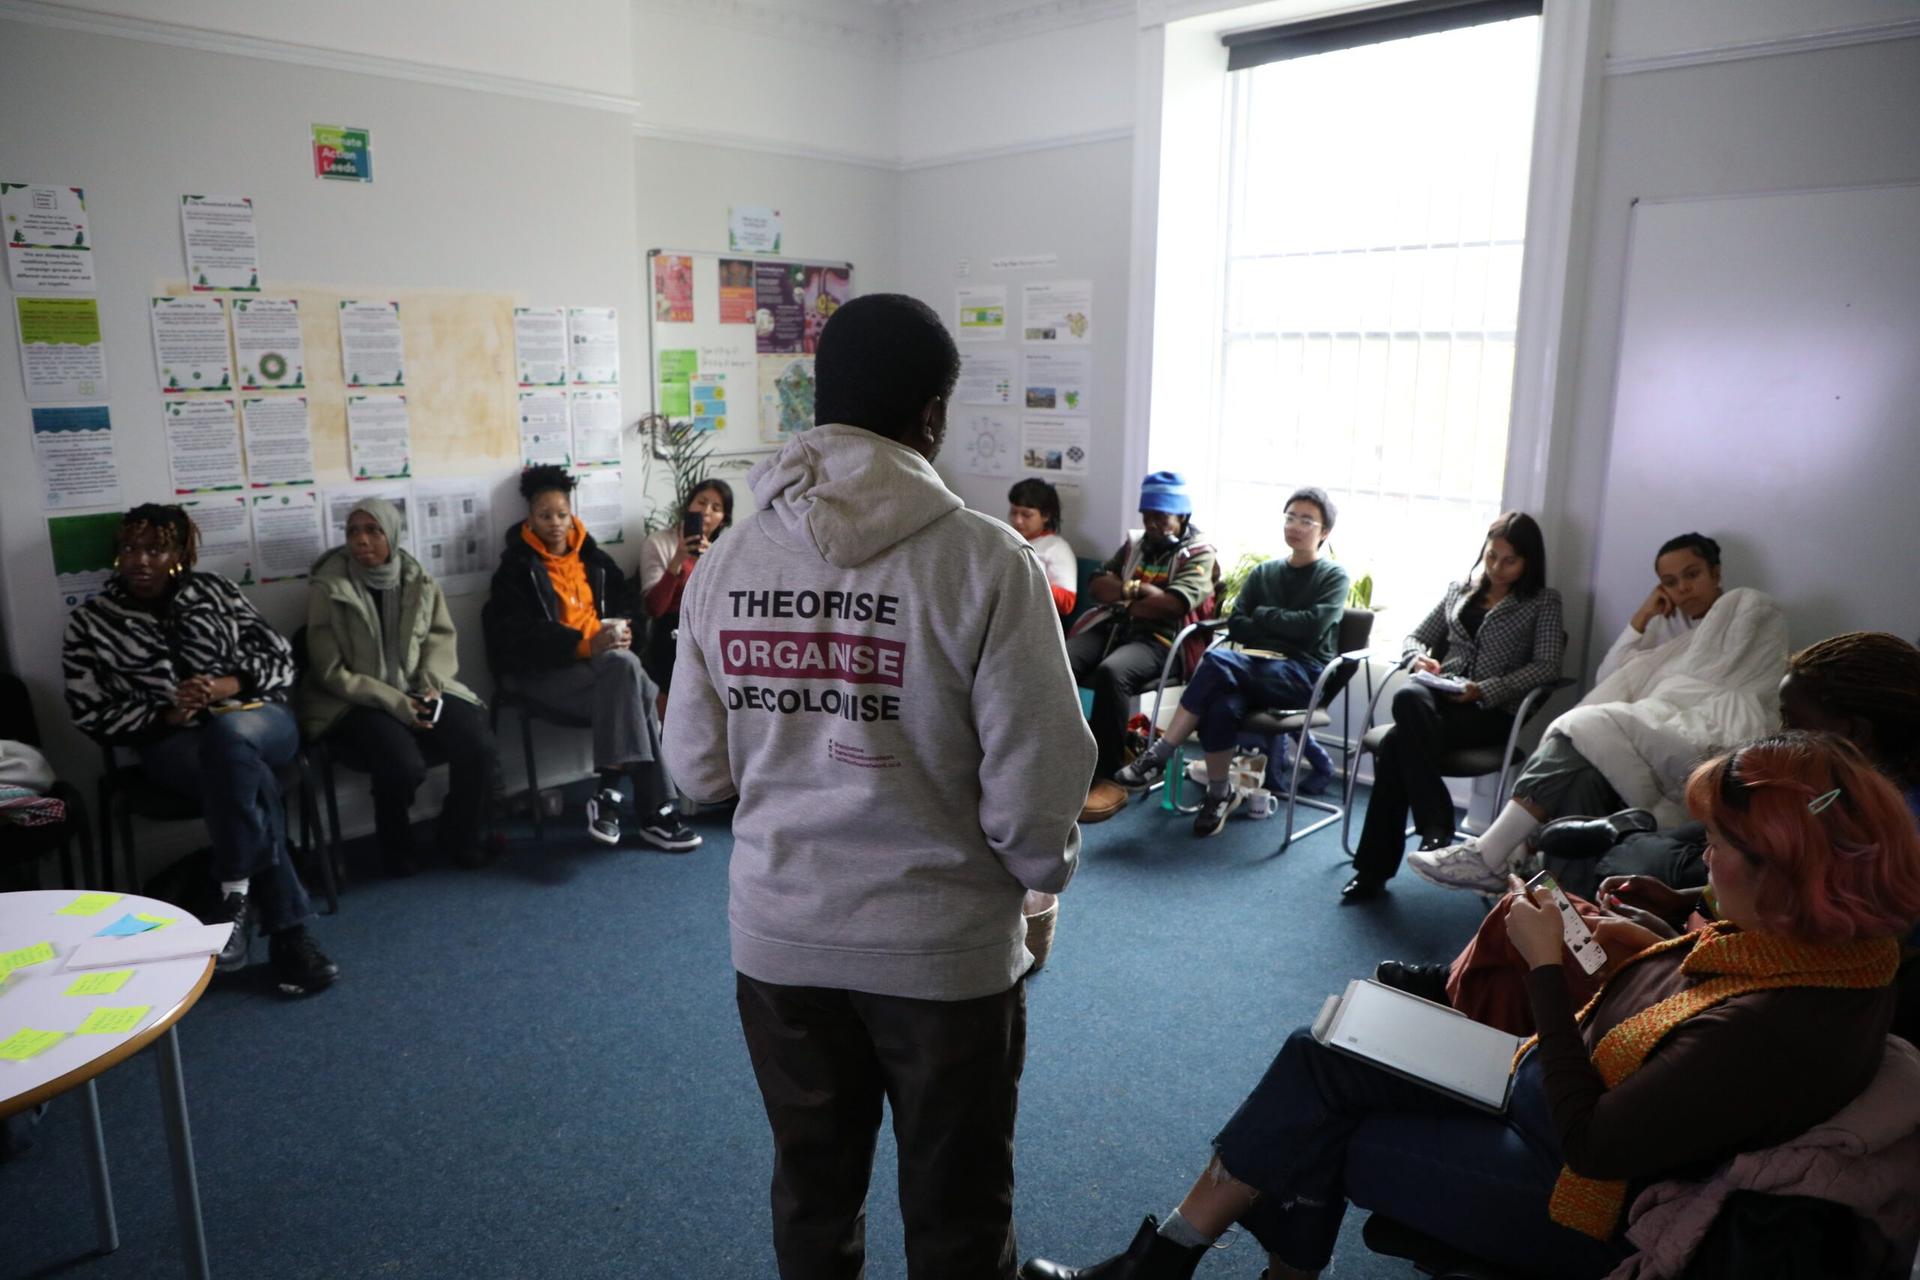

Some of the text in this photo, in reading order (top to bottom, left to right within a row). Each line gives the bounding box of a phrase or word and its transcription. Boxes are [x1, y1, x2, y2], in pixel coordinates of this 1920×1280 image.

[320, 134, 362, 147] Climate
[322, 147, 356, 160] Action
[324, 160, 356, 172] Leeds
[729, 590, 899, 625] THEORISE
[727, 640, 900, 678] ORGANISE
[728, 686, 900, 722] DECOLONISE
